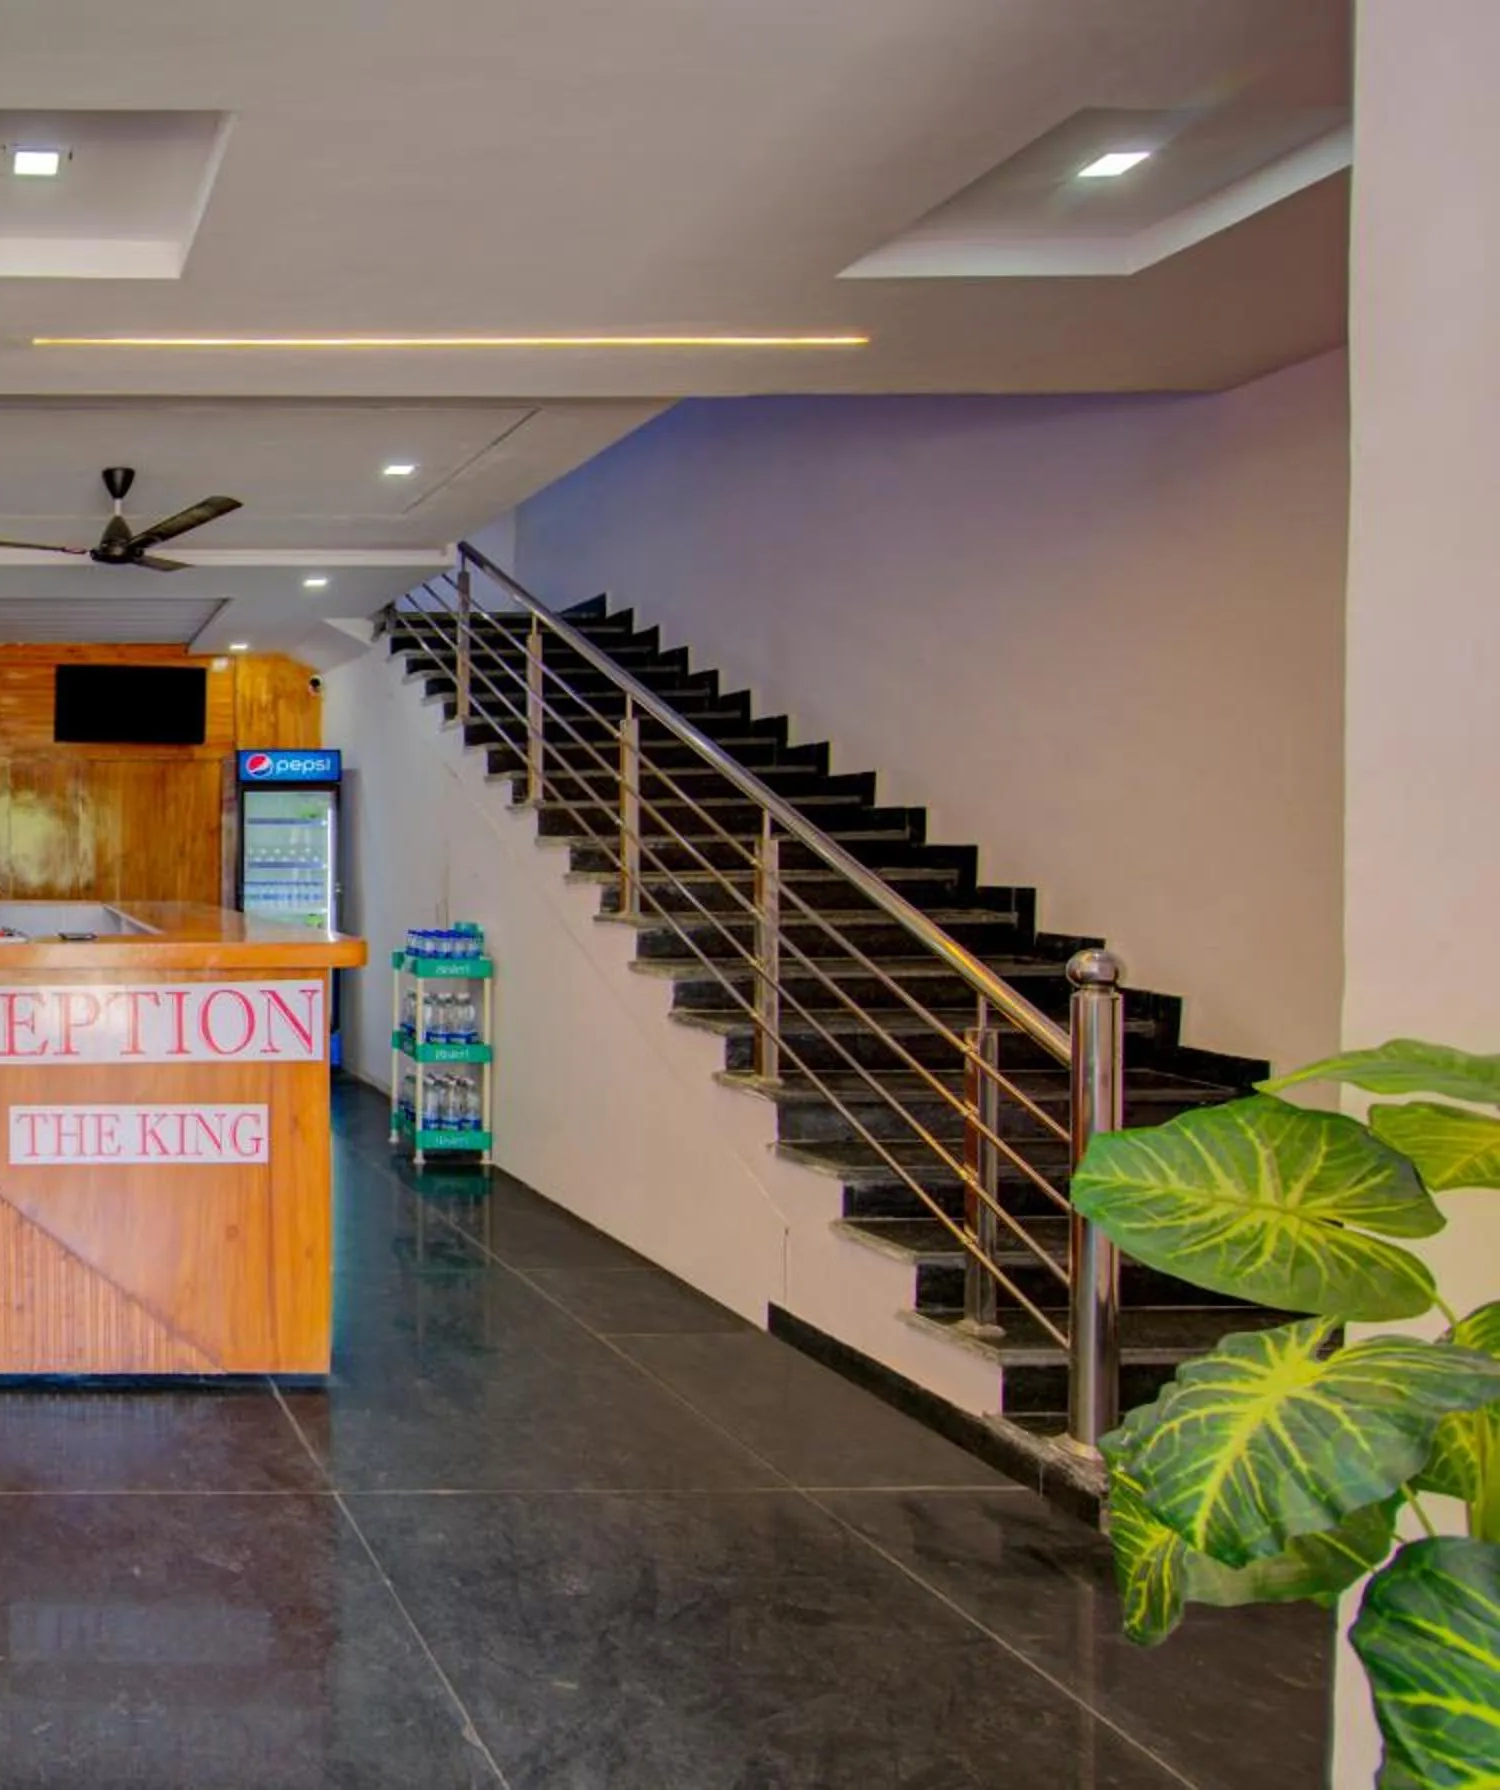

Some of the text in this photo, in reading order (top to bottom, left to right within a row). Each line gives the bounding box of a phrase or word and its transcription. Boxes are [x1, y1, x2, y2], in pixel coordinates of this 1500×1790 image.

[276, 758, 331, 774] pepsi
[15, 1111, 264, 1158] THE KING
